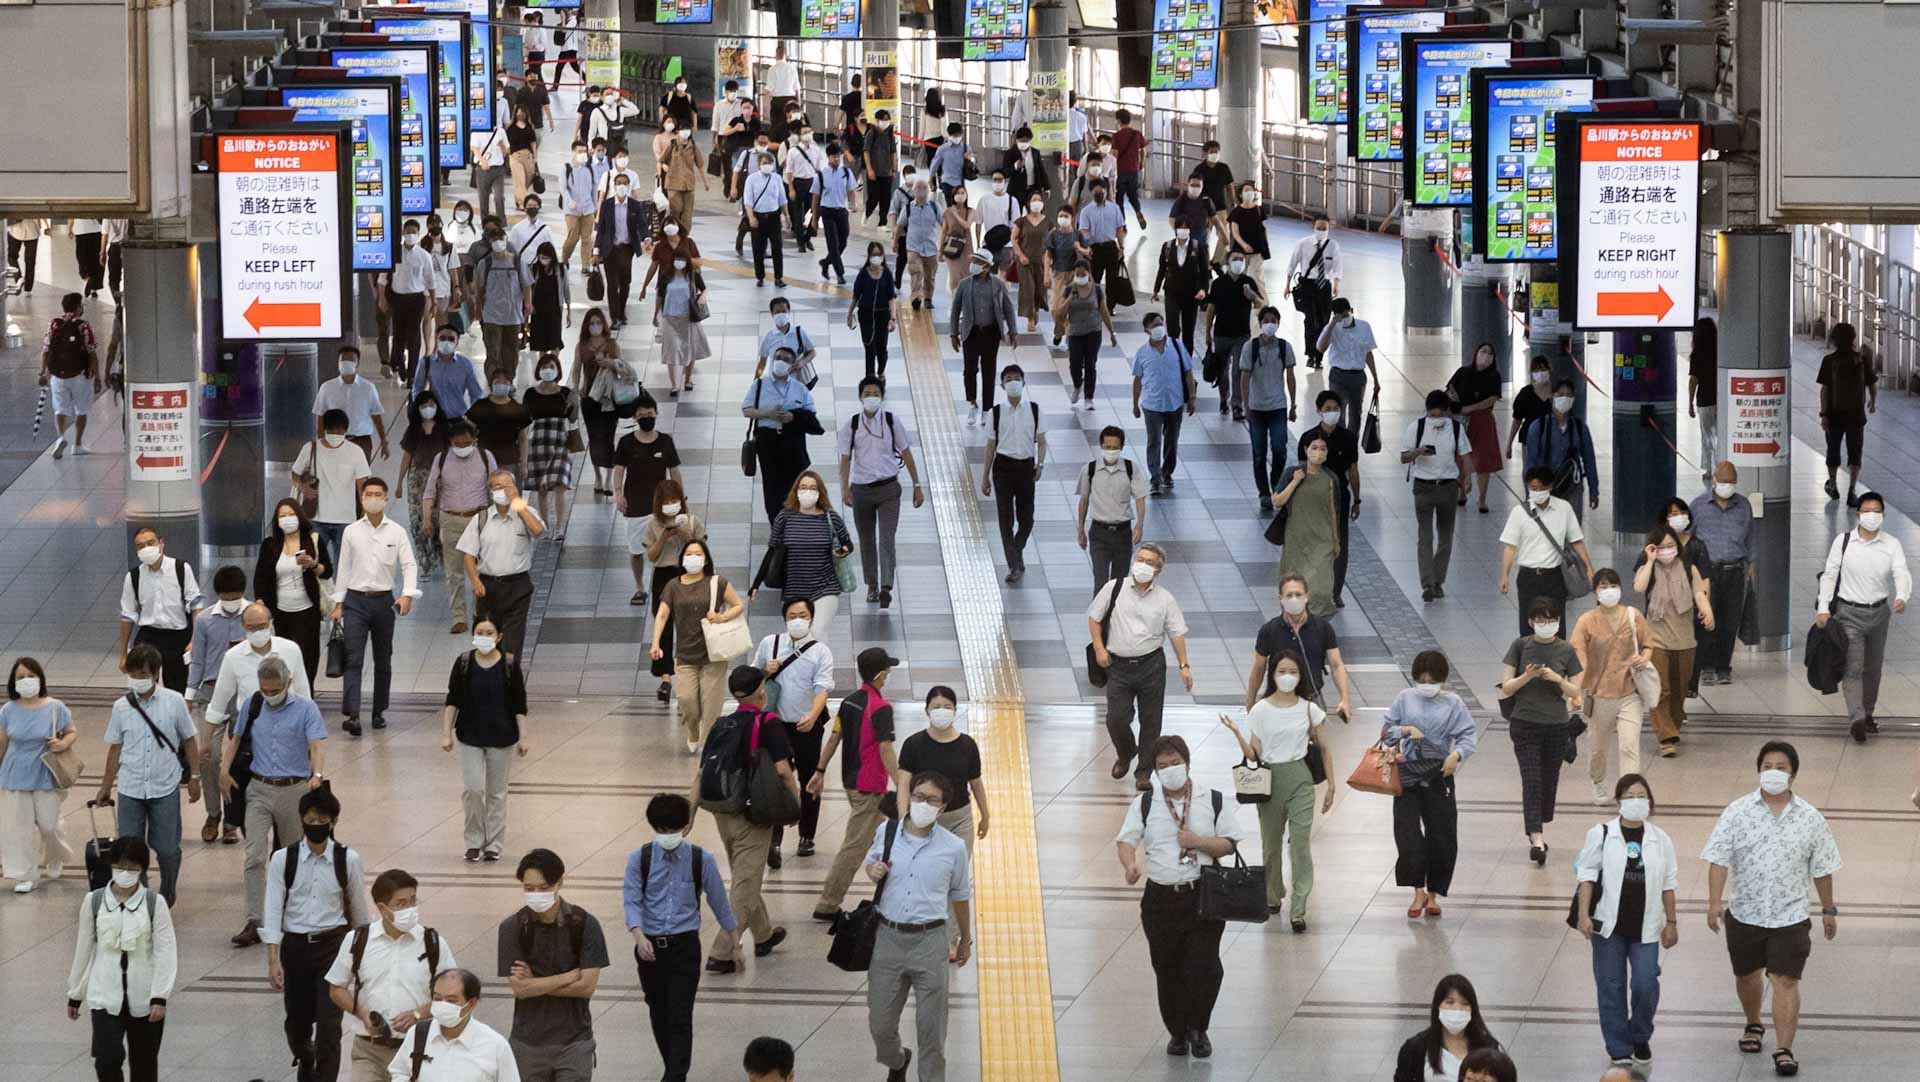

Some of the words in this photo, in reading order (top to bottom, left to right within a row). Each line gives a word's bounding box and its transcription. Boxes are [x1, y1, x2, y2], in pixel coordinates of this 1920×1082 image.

[1587, 129, 1693, 142] 品川駅からのおねがい
[224, 139, 330, 153] 品川駅からのおねがい
[1616, 146, 1662, 158] NOTICE
[254, 157, 300, 168] NOTICE
[1597, 166, 1681, 181] 朝の混雑時は
[236, 176, 320, 192] 朝の混雑時は
[1600, 186, 1677, 204] 通路右端を
[240, 197, 317, 215] 通路左端を
[1589, 209, 1687, 225] ご通行ください
[230, 220, 329, 236] ご通行ください
[1620, 232, 1656, 244] Please
[262, 243, 298, 254] Please
[1598, 250, 1633, 262] KEEP
[1636, 249, 1676, 262] RIGHT
[245, 260, 280, 272] KEEP
[284, 260, 316, 272] LEFT
[1594, 268, 1626, 282] during
[1630, 268, 1653, 279] rush
[1656, 268, 1679, 279] hour
[238, 280, 270, 293] during
[274, 280, 296, 290] rush
[300, 280, 323, 290] hour
